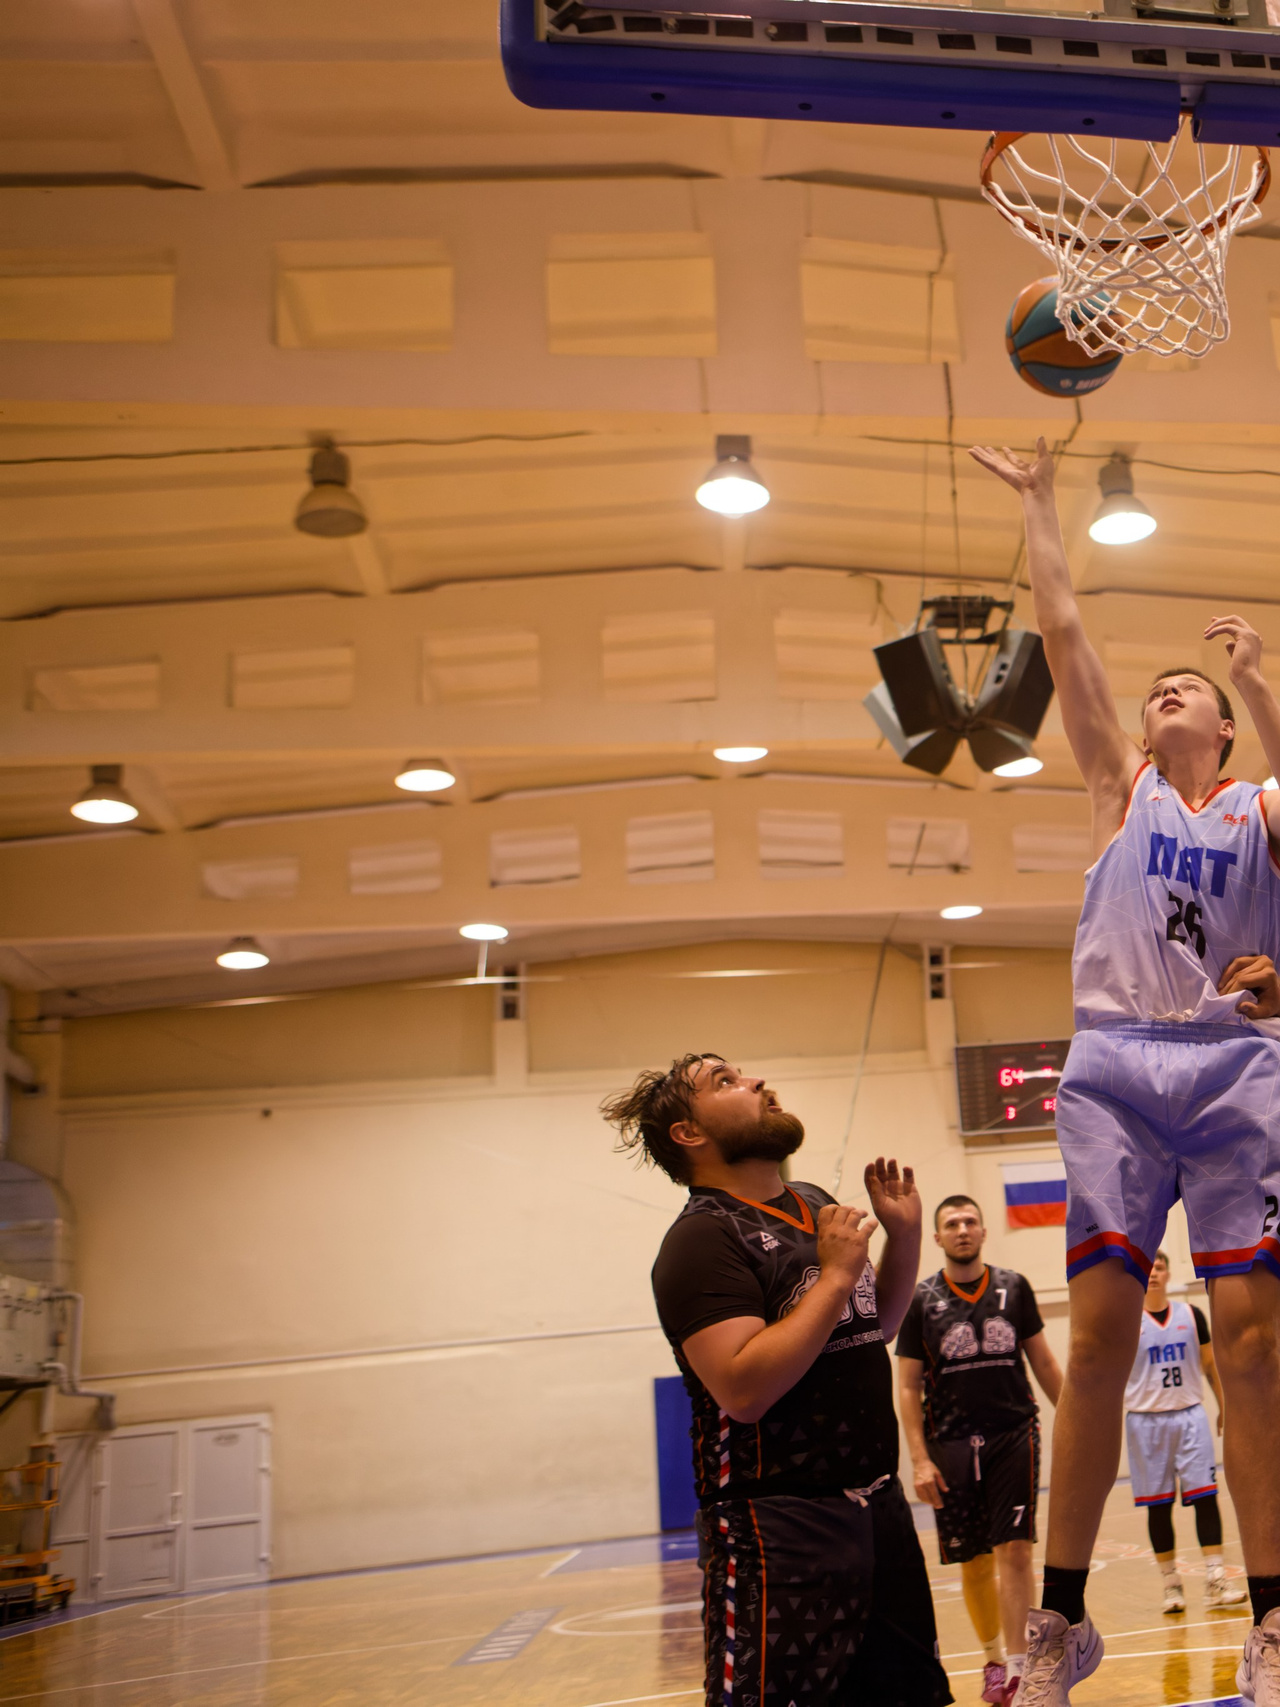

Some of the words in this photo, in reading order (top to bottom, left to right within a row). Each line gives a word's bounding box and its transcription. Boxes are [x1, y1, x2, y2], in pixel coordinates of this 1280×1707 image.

[1166, 891, 1206, 960] 26
[1000, 1067, 1023, 1087] 64
[995, 1288, 1007, 1310] 7
[1161, 1366, 1182, 1388] 28
[1012, 1504, 1025, 1527] 7
